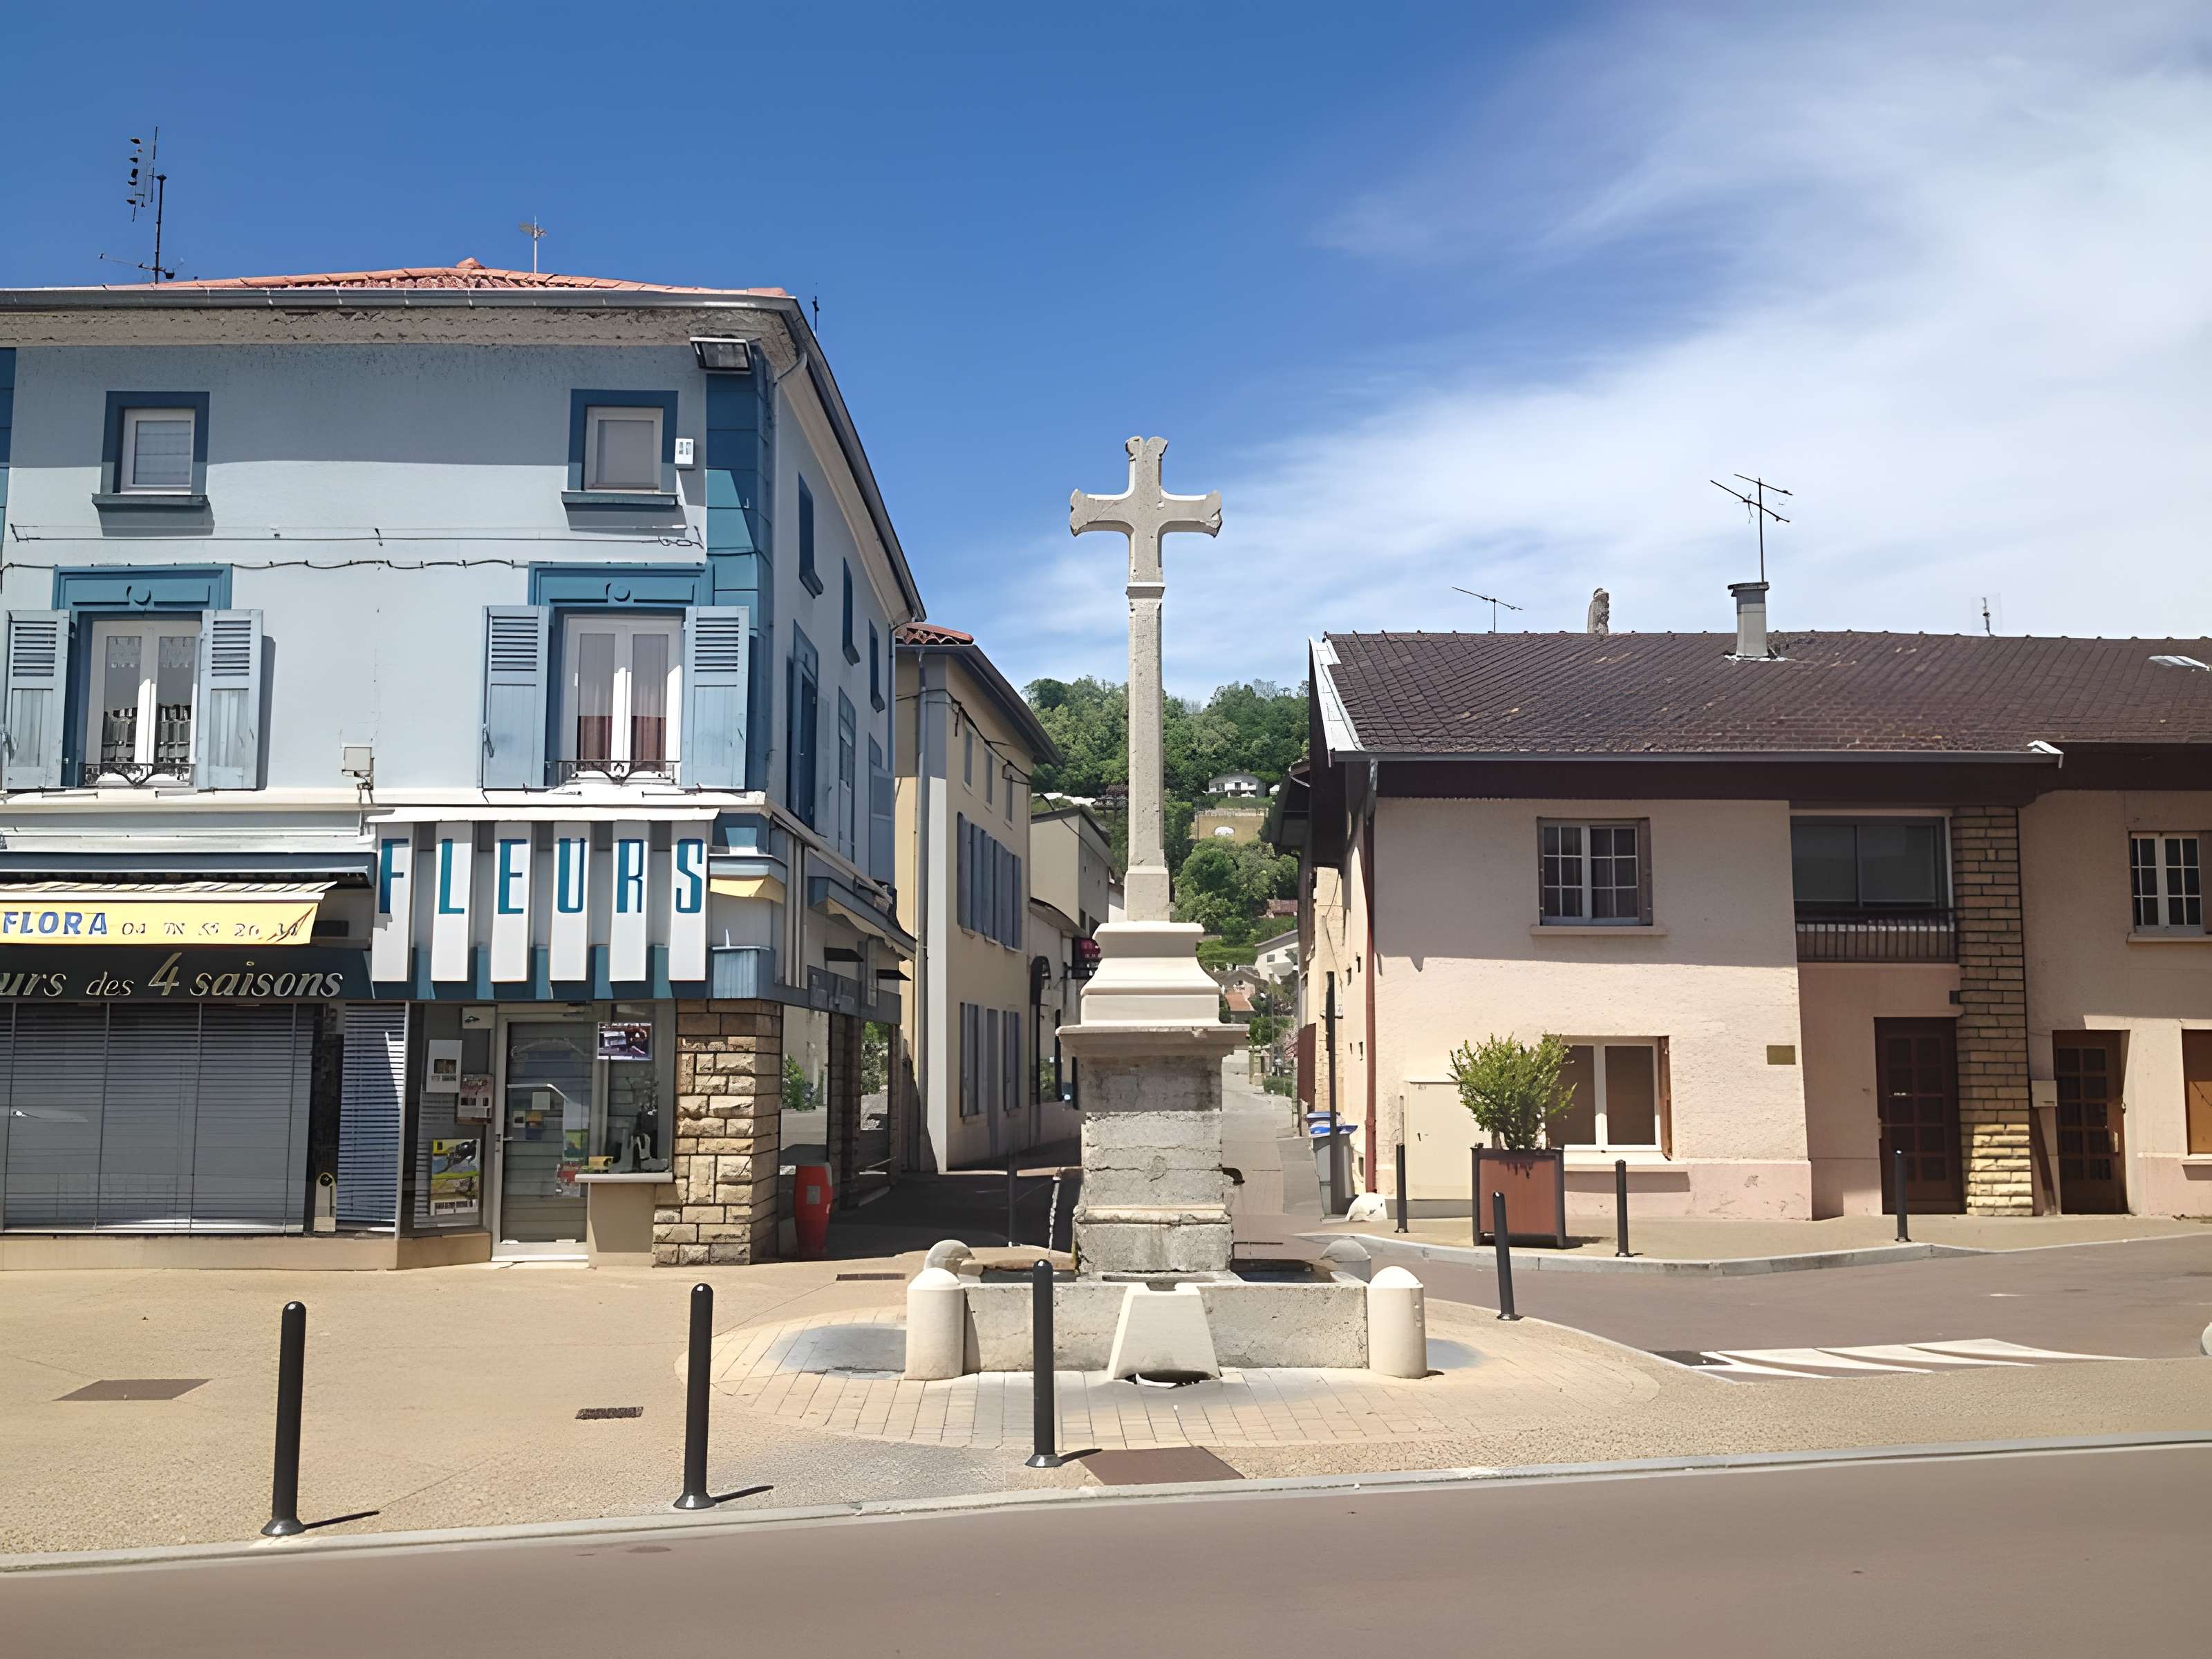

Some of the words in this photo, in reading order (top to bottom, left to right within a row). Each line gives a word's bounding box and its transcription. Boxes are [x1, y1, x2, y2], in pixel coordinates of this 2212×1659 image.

[379, 838, 704, 915] FLEURS
[3, 911, 108, 935] FLORA
[85, 971, 135, 996] des
[147, 952, 183, 996] 4
[189, 960, 344, 997] saisons
